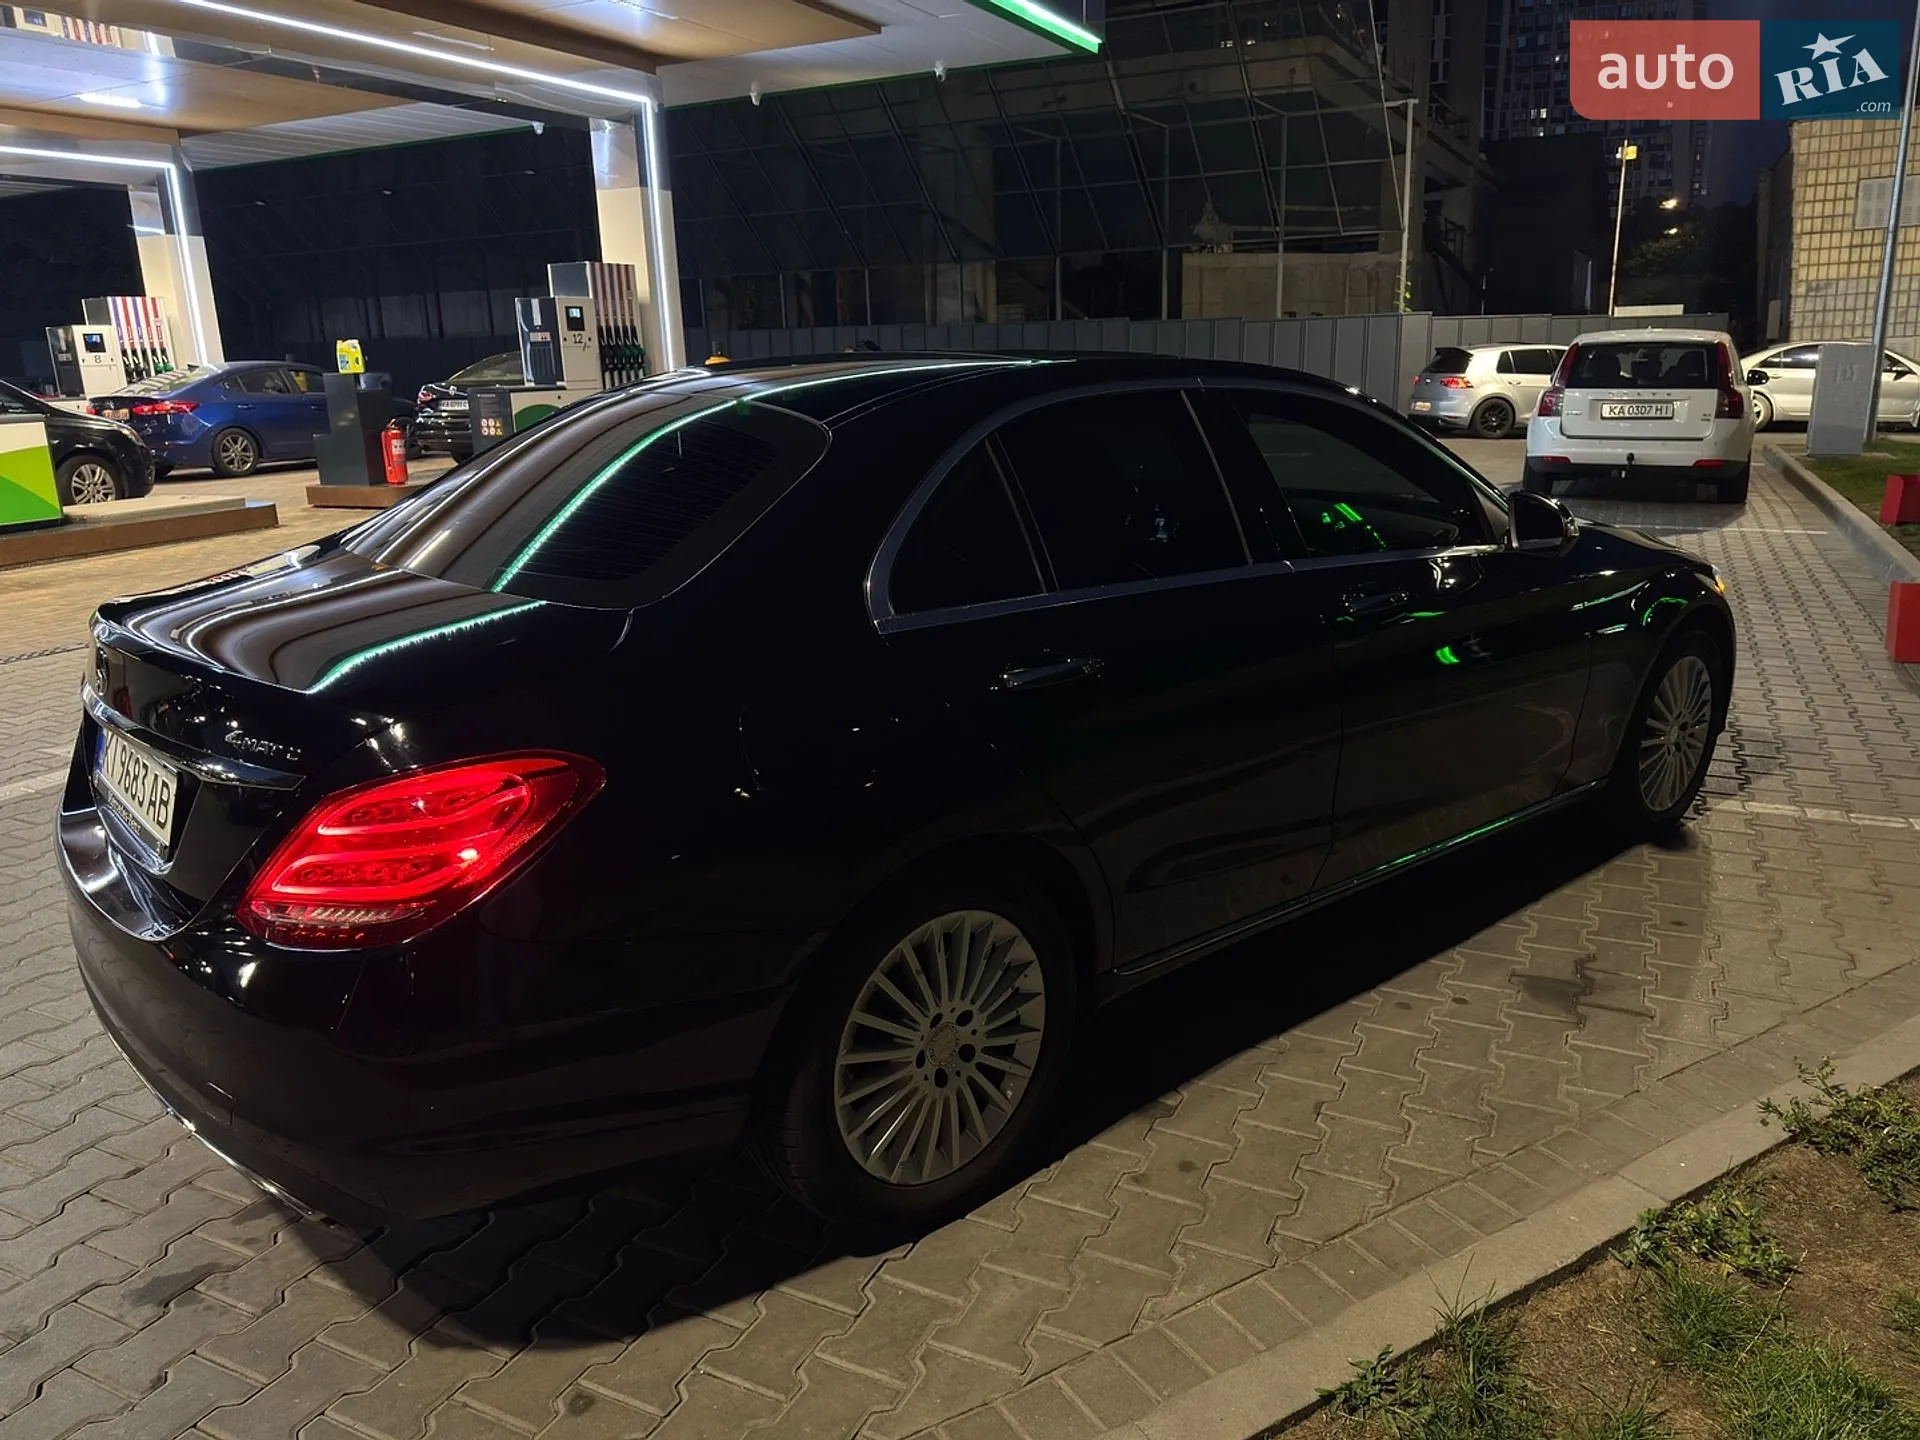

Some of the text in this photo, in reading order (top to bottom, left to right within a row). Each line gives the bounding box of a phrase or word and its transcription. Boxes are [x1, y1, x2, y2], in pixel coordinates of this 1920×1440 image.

[573, 333, 583, 344] 12
[1608, 405, 1625, 416] KA
[1627, 405, 1653, 416] 0307
[117, 742, 150, 808] 9683
[146, 772, 171, 830] AB
